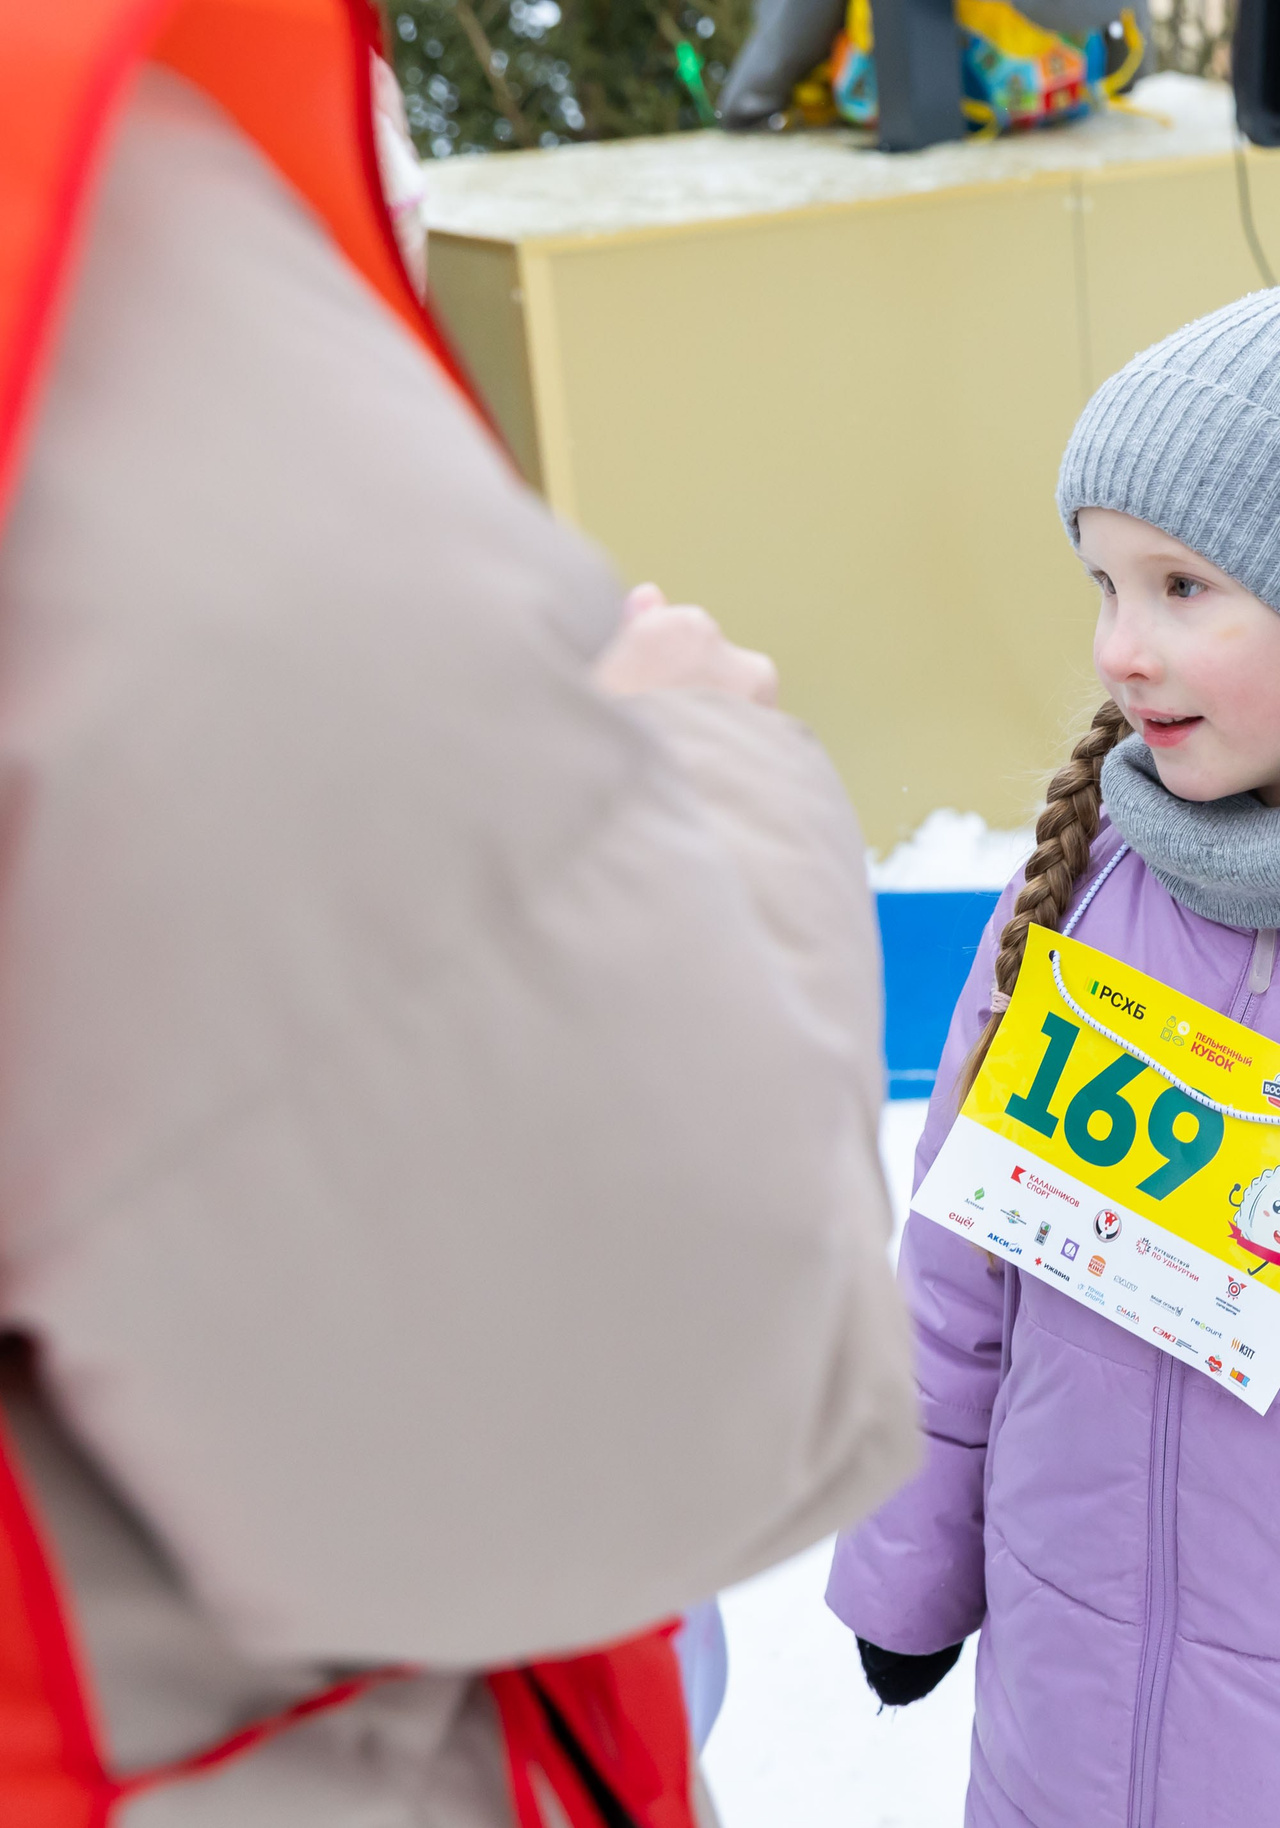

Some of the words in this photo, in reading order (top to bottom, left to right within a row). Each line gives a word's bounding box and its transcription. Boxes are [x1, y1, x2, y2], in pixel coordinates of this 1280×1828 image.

[1099, 985, 1147, 1021] РСХБ
[1190, 1041, 1235, 1073] КУБОК
[1195, 1031, 1253, 1067] ПЕЛЬМЕННЫЙ
[1004, 1011, 1225, 1201] 169
[1026, 1181, 1051, 1200] СПОРТ
[1028, 1173, 1080, 1208] КАЛАШНИКОВ
[948, 1211, 975, 1230] ещё!
[987, 1232, 1023, 1255] АКСИОН
[1088, 1263, 1103, 1275] KING
[1151, 1251, 1162, 1261] ПО
[1163, 1257, 1200, 1282] УДМУРТИИ
[1116, 1304, 1140, 1323] СМАЙЛ
[1152, 1325, 1177, 1343] СЭМЗ
